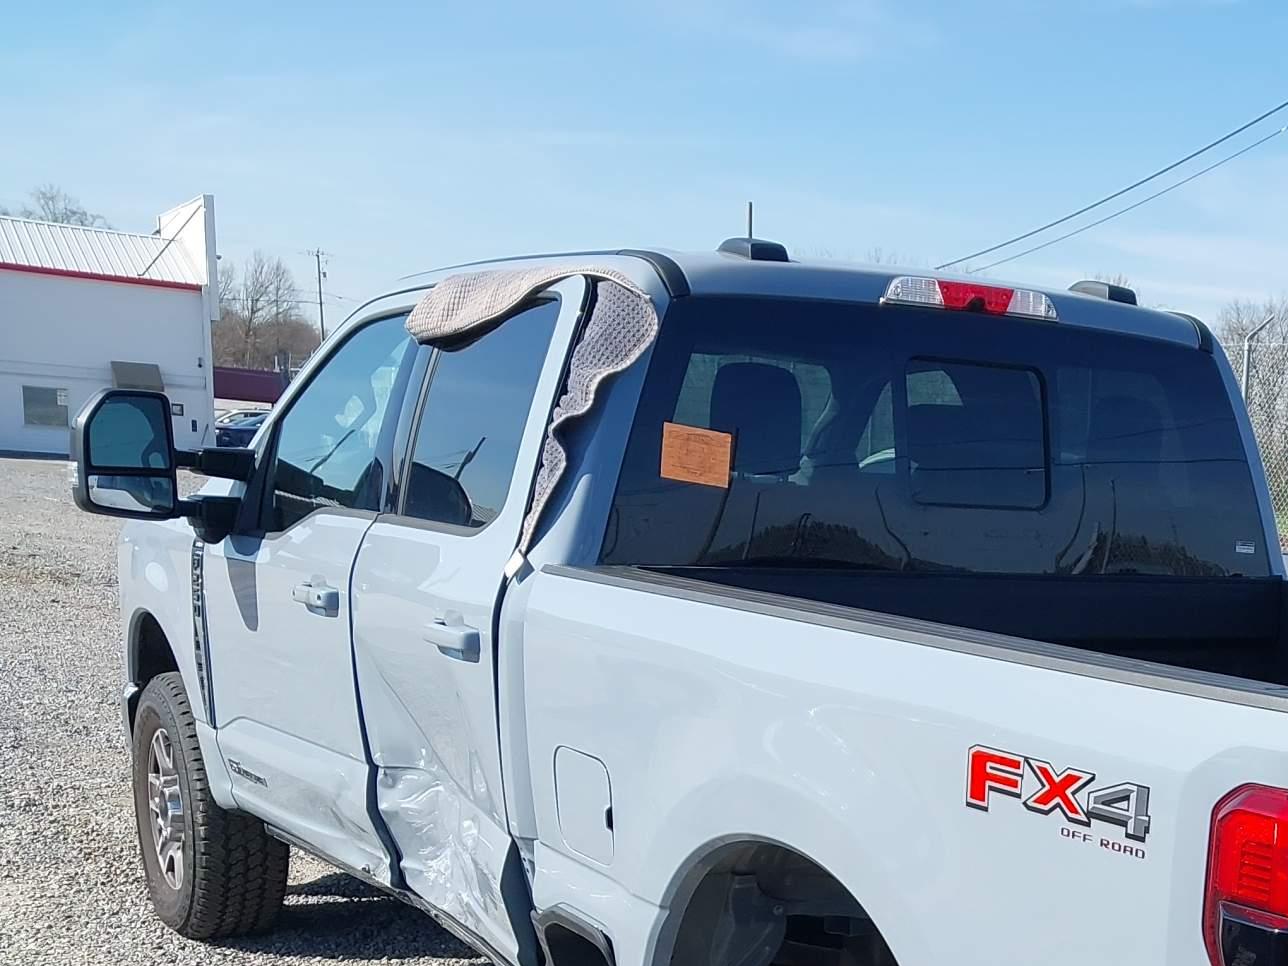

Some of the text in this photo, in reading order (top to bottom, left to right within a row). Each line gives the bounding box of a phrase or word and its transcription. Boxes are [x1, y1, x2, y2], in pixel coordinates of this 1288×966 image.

[966, 744, 1151, 843] FX4
[1060, 827, 1146, 860] OFF ROAD
